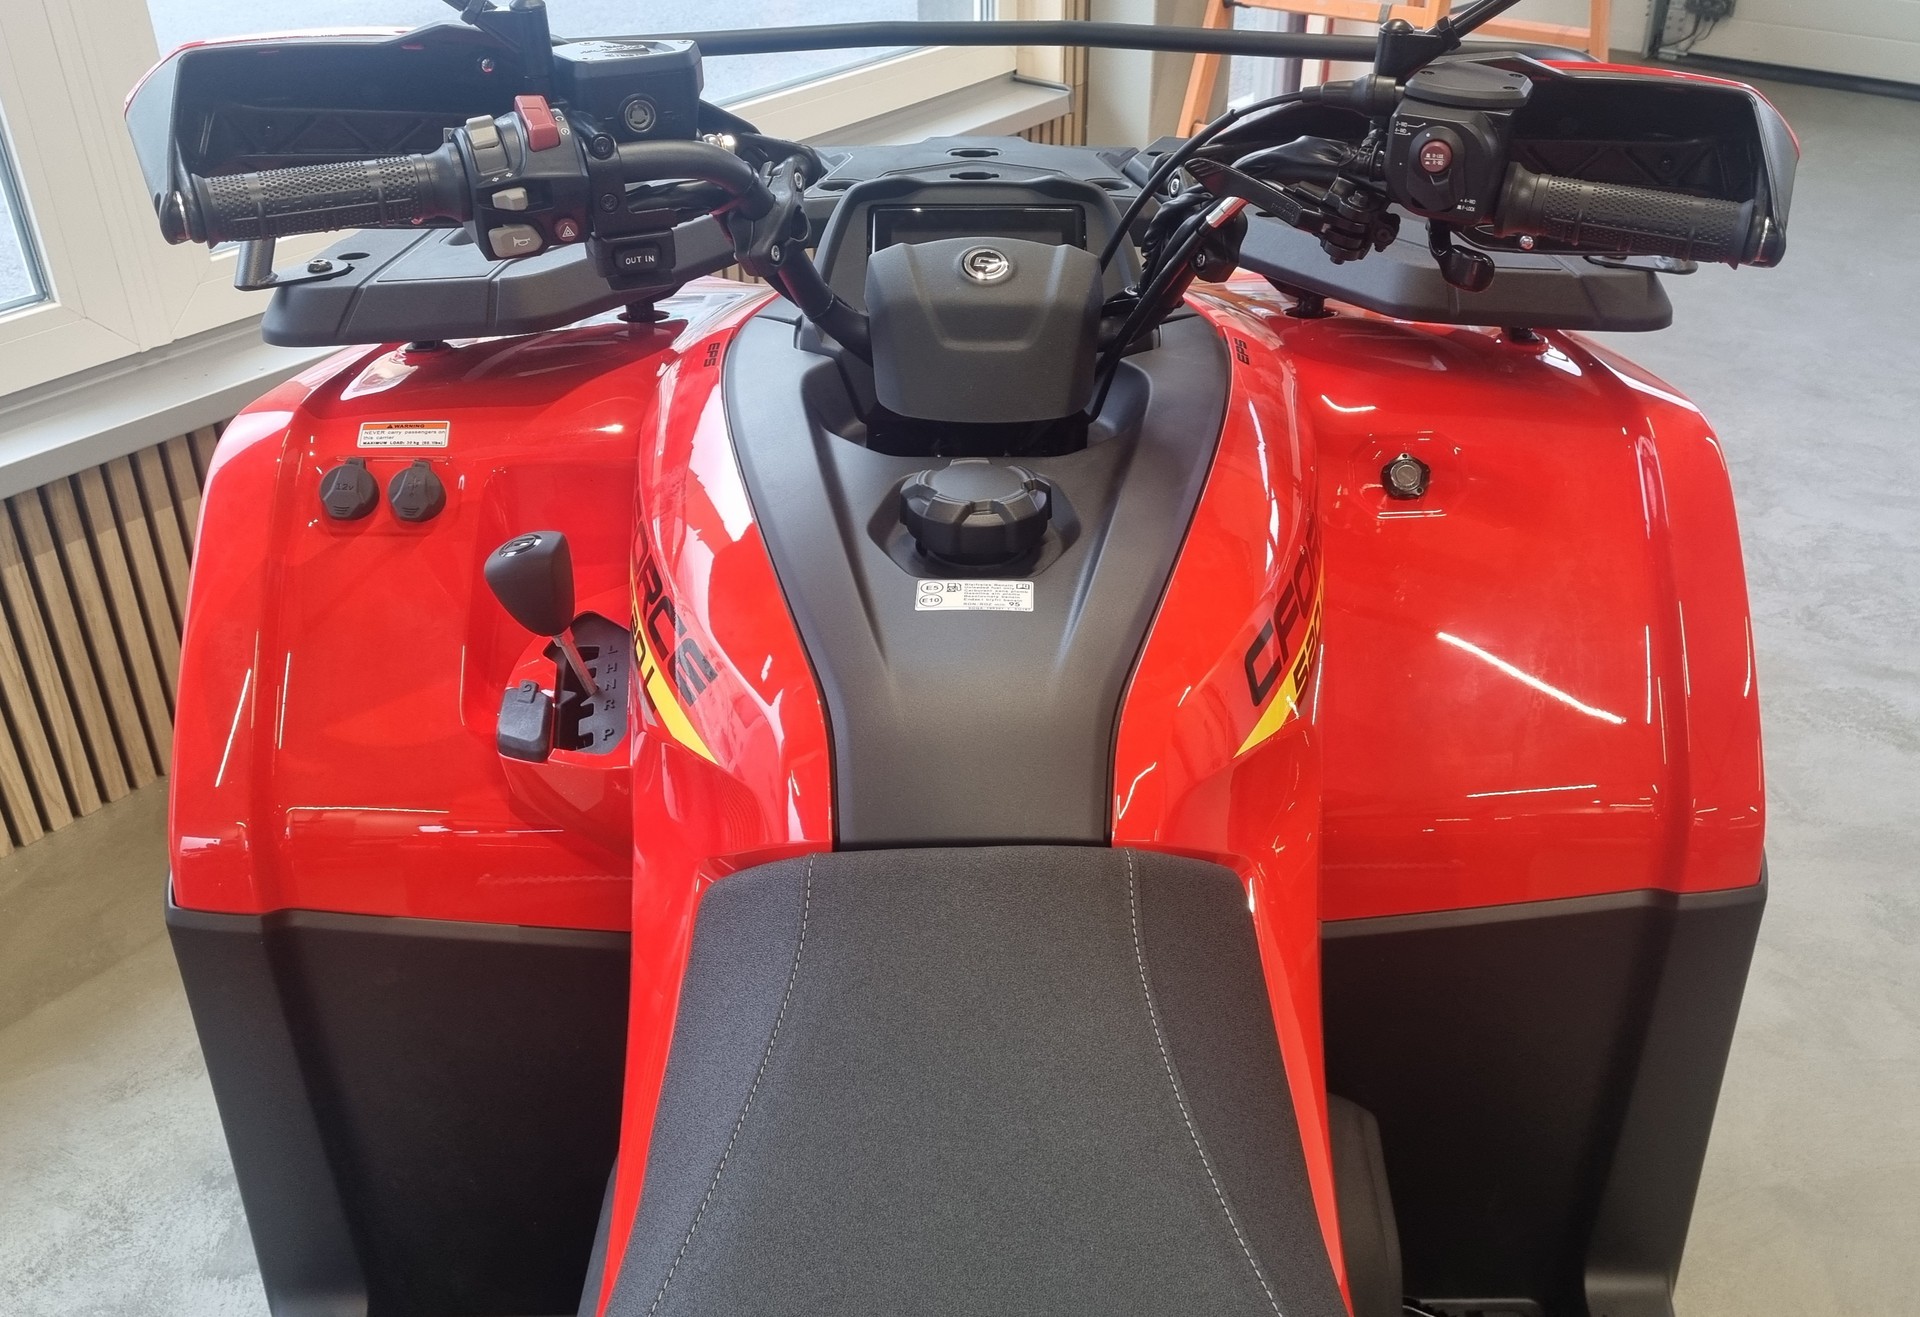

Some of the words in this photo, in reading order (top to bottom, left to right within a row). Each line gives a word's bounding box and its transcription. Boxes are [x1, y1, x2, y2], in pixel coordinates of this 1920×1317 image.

[625, 256, 641, 265] OUT
[644, 254, 655, 263] IN
[703, 342, 720, 368] EPS
[1233, 337, 1250, 366] EPS
[603, 727, 615, 742] P
